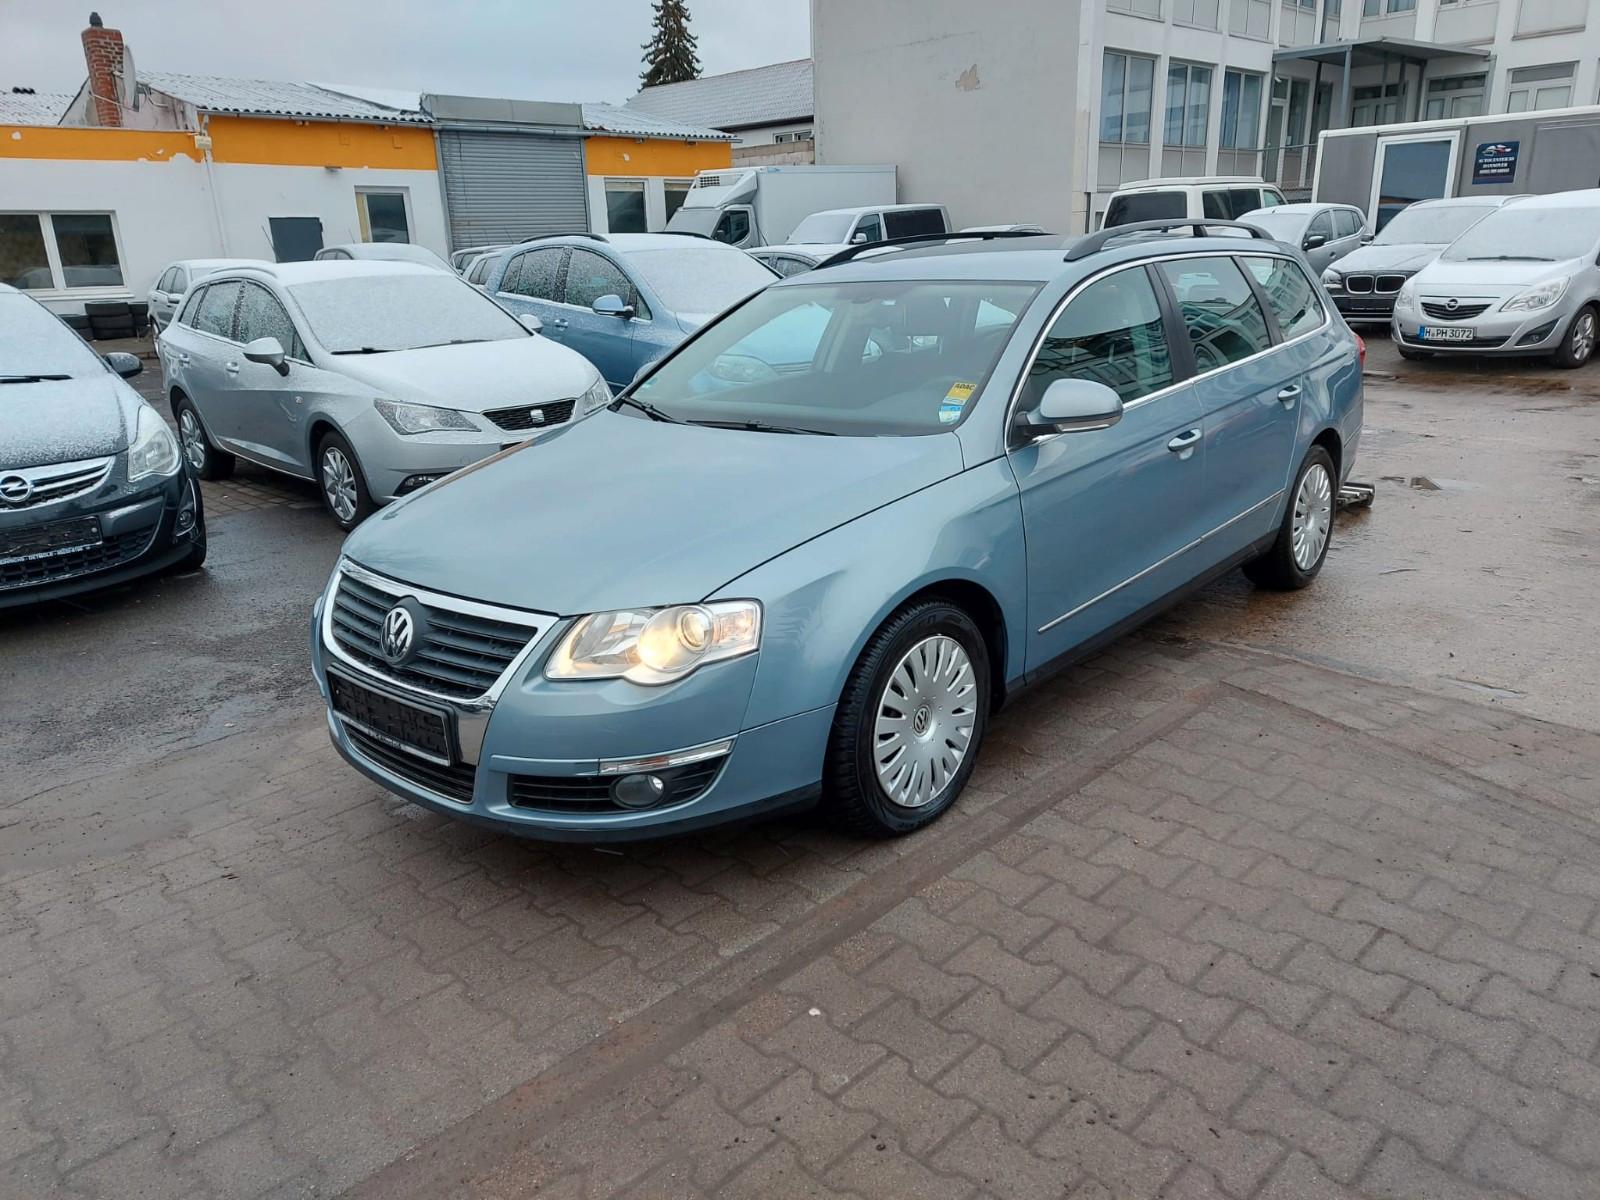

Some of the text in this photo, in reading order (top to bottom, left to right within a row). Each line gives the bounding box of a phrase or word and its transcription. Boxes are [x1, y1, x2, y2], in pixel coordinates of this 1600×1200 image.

[1425, 328, 1473, 338] H PH 3072
